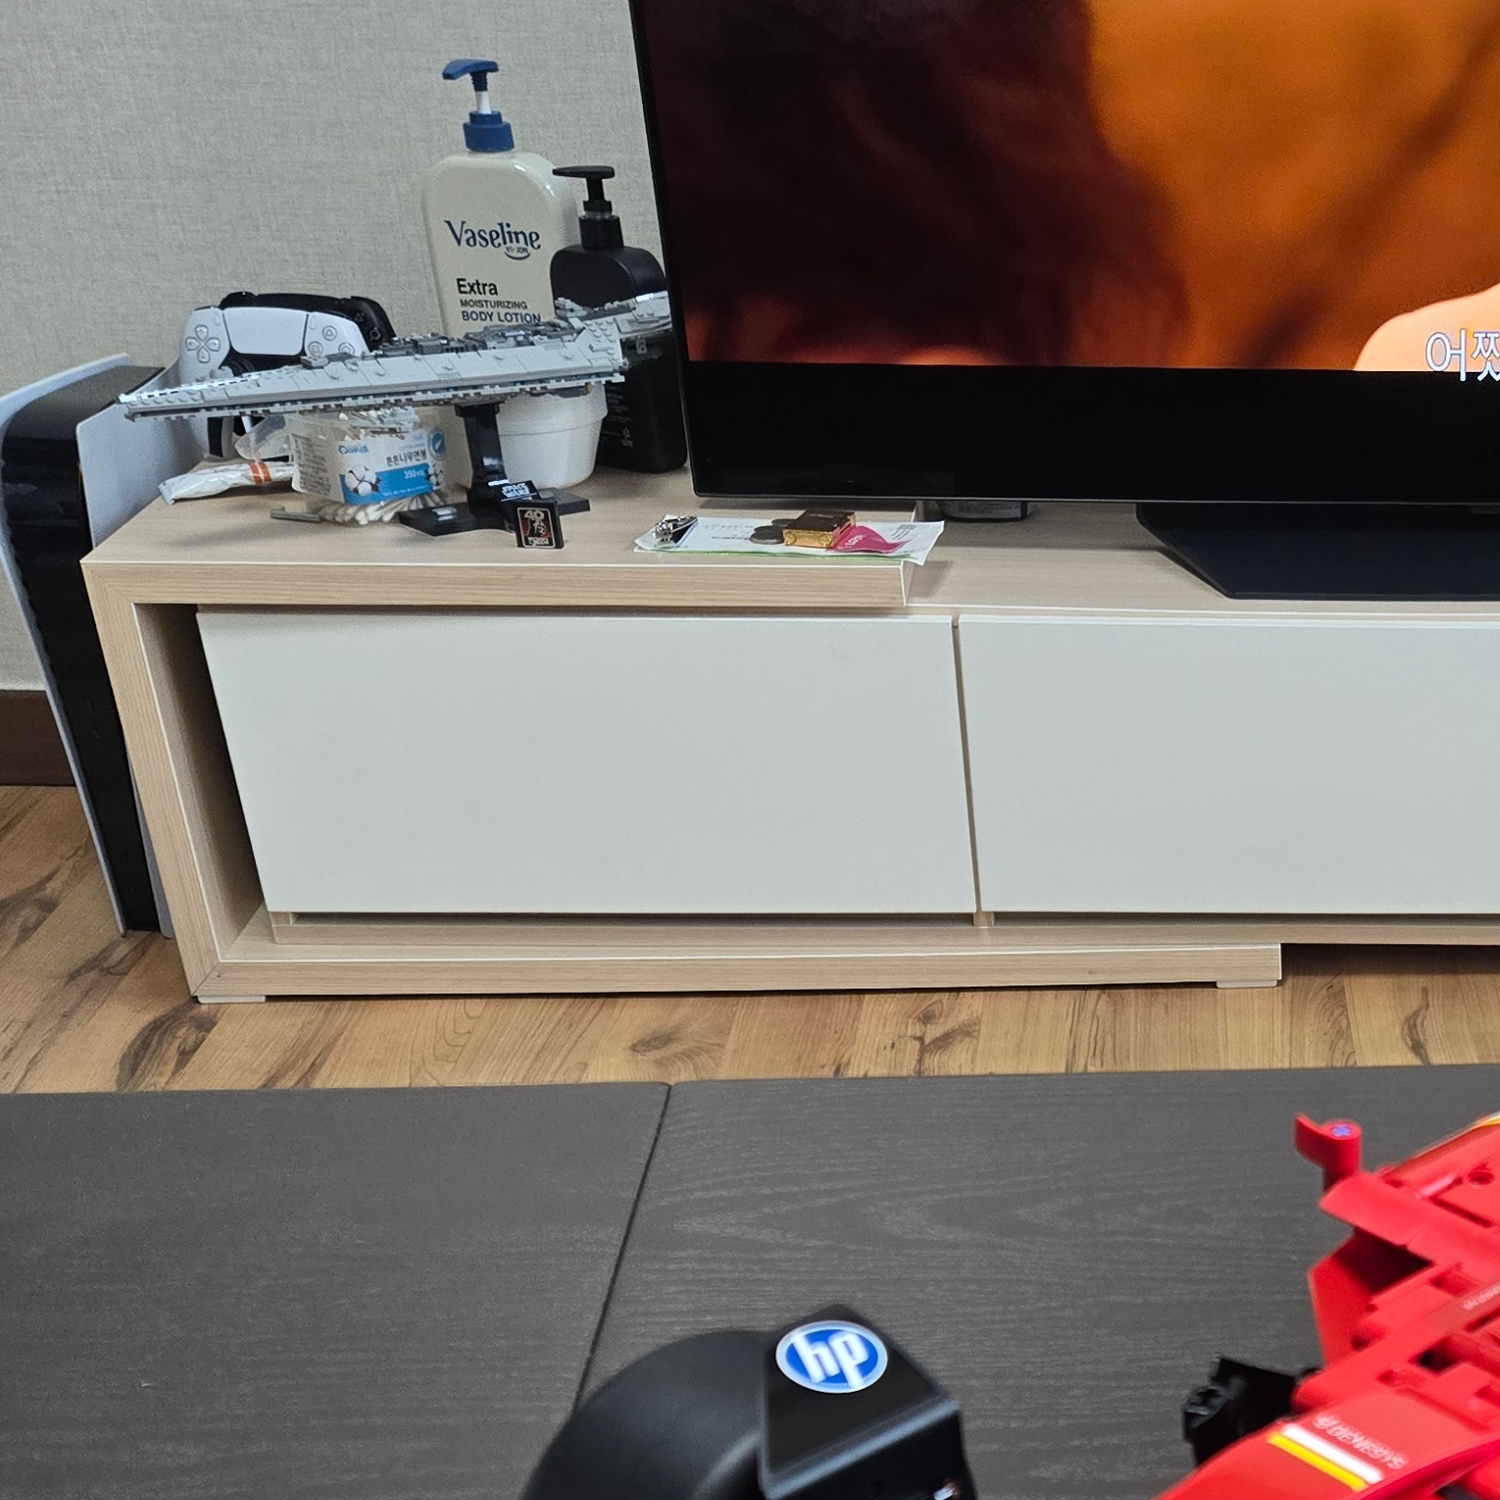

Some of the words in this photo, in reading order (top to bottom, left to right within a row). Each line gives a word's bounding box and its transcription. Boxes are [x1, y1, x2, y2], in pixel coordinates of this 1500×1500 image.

[443, 220, 541, 250] Vaseline
[456, 278, 498, 295] Extra
[460, 299, 527, 310] MOISTURIZING
[461, 310, 494, 321] BODY
[498, 313, 541, 323] LOTION
[785, 1328, 879, 1391] hp
